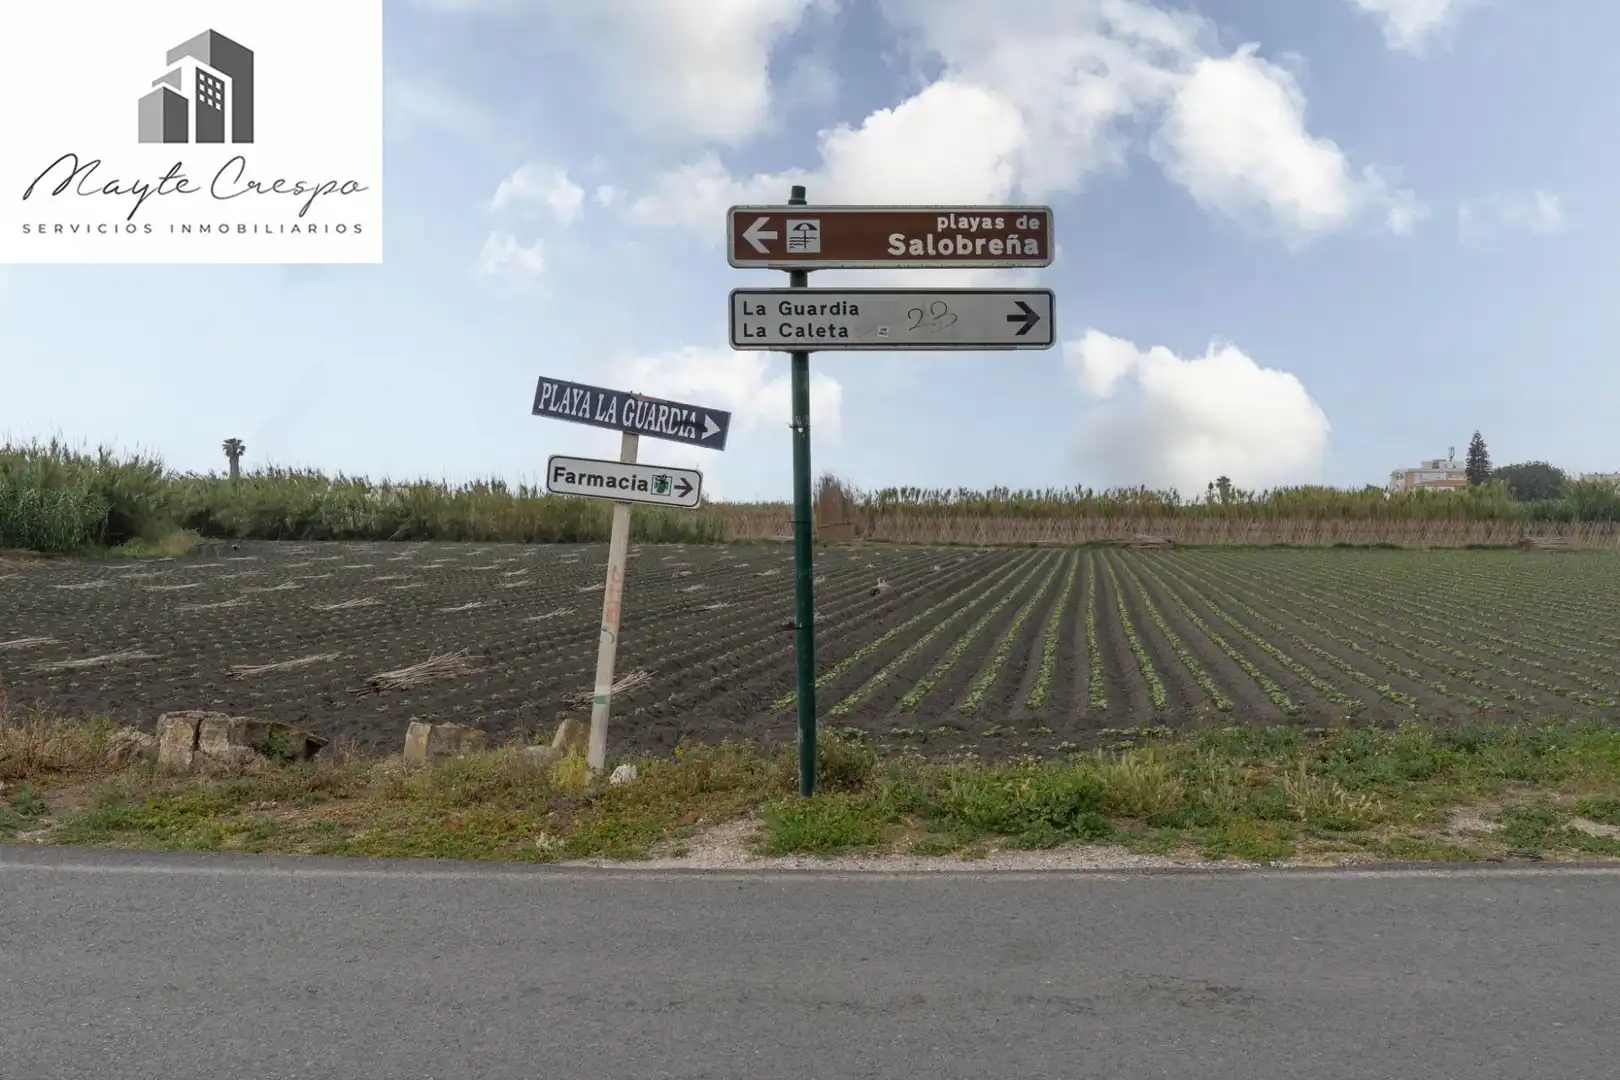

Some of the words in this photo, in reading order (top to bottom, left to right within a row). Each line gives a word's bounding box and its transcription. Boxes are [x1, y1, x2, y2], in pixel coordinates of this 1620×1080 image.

[937, 214, 1004, 232] playas
[1015, 214, 1040, 230] de
[888, 233, 1040, 256] Salobreña
[743, 301, 766, 316] La
[779, 301, 860, 317] Guardia
[743, 323, 766, 338] La
[779, 323, 849, 339] Caleta
[538, 382, 591, 420] PLAYA
[594, 393, 617, 425] LA
[622, 398, 697, 439] GUARDIA
[553, 466, 649, 492] Farmacia
